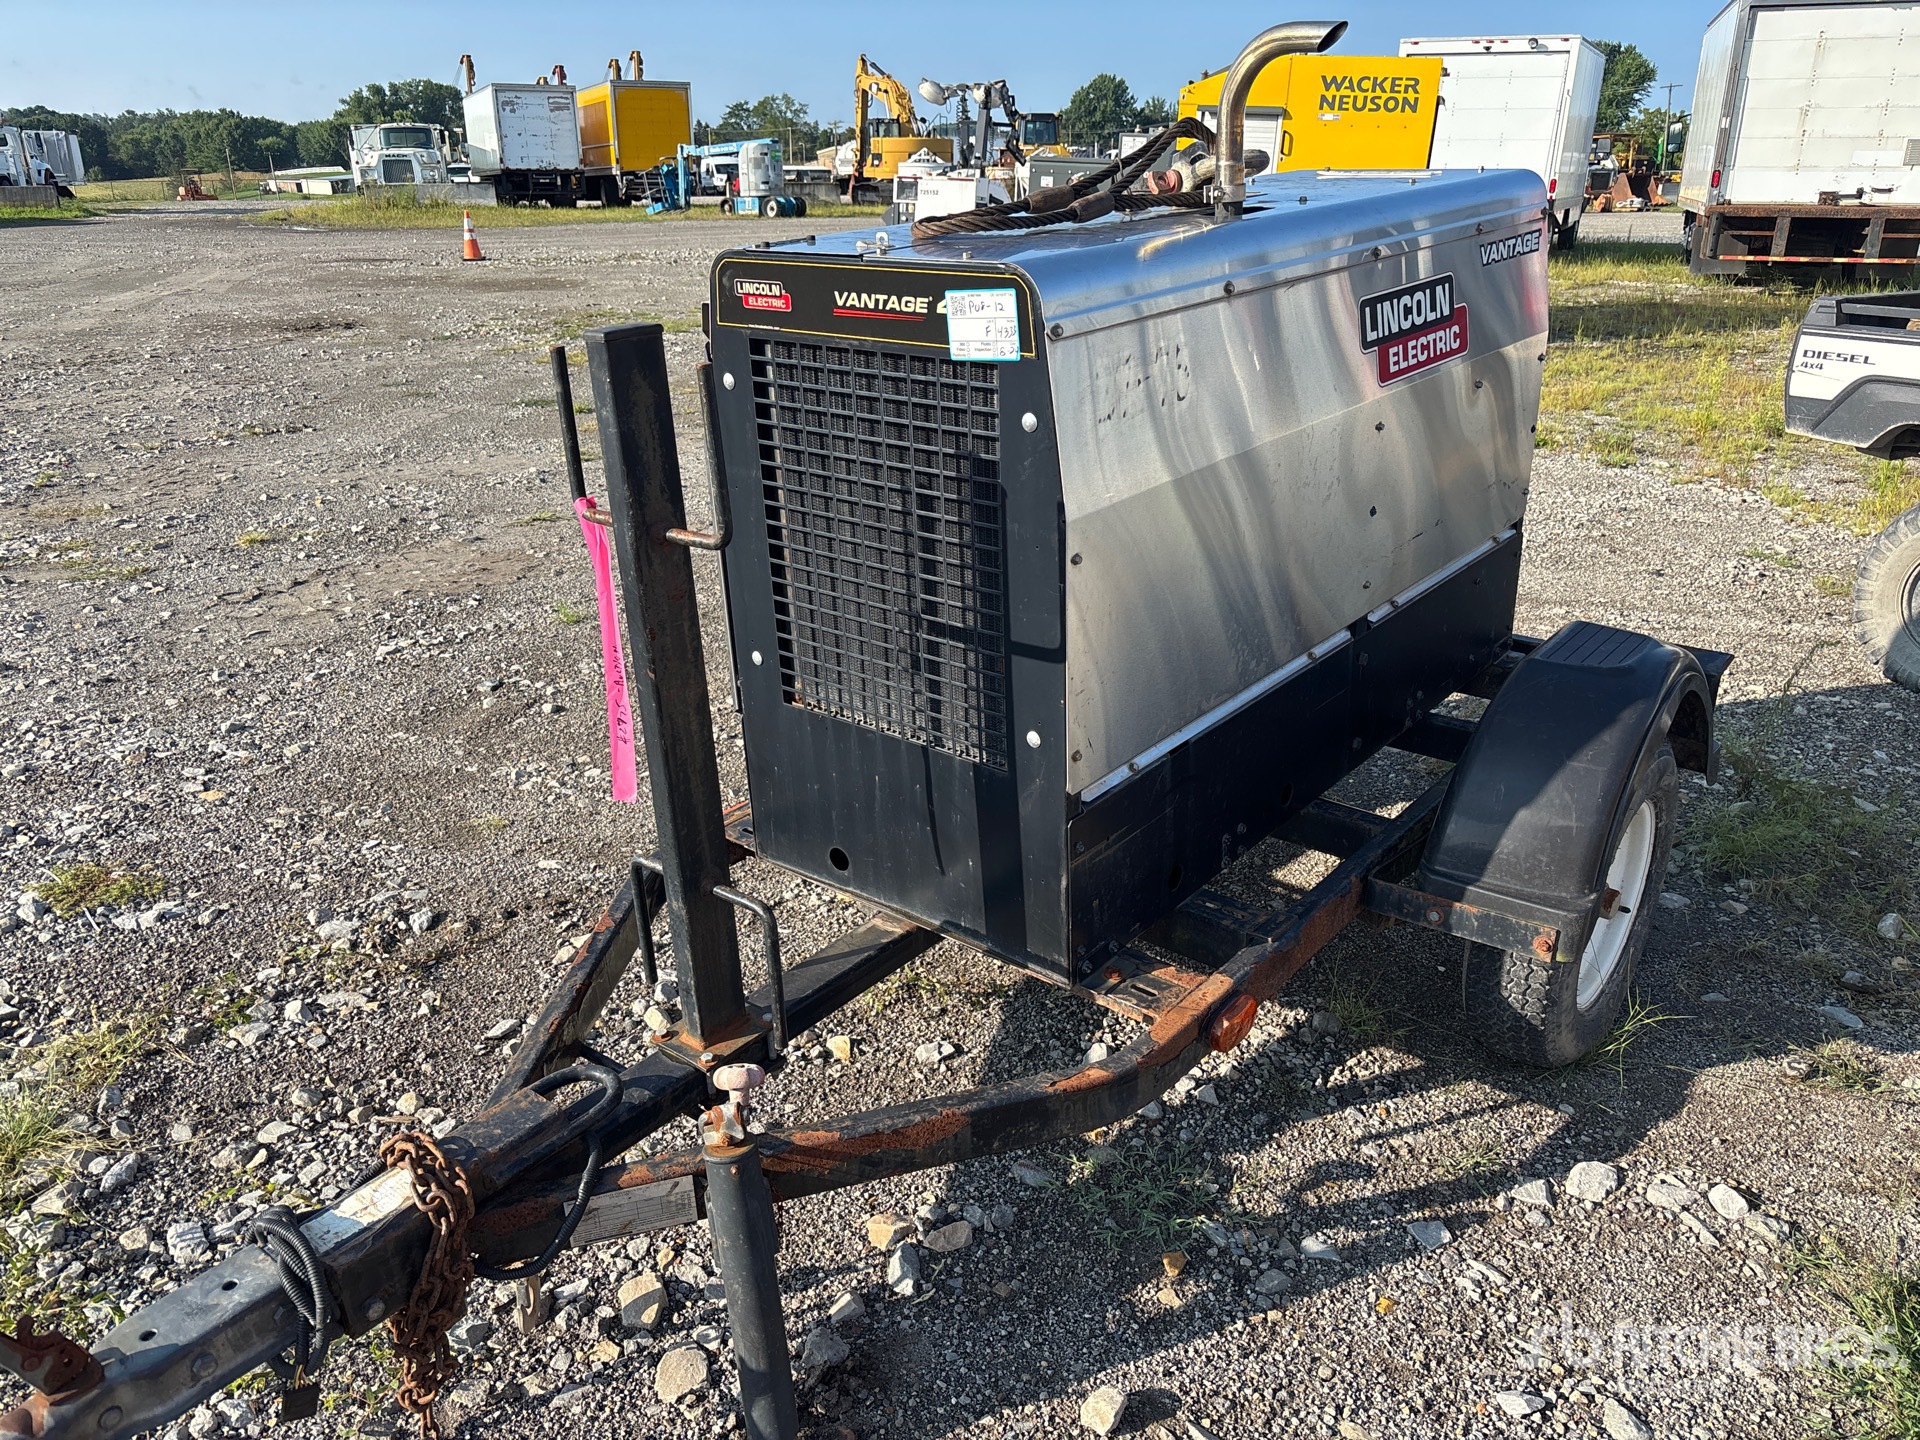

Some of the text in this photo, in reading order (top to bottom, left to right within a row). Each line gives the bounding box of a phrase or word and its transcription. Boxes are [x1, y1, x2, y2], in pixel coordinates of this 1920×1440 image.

[1320, 75, 1421, 95] WACKER
[1318, 95, 1420, 114] NEUSON
[1480, 231, 1541, 265] VANTAGE
[736, 281, 781, 297] LINCOLN
[747, 296, 787, 309] ELECTRIC
[833, 290, 929, 313] VANTAGE
[1364, 282, 1451, 343] LINCOLN
[1388, 324, 1461, 374] ELECTRIC
[1802, 349, 1876, 366] DIESEL
[1799, 361, 1824, 371] 4x4
